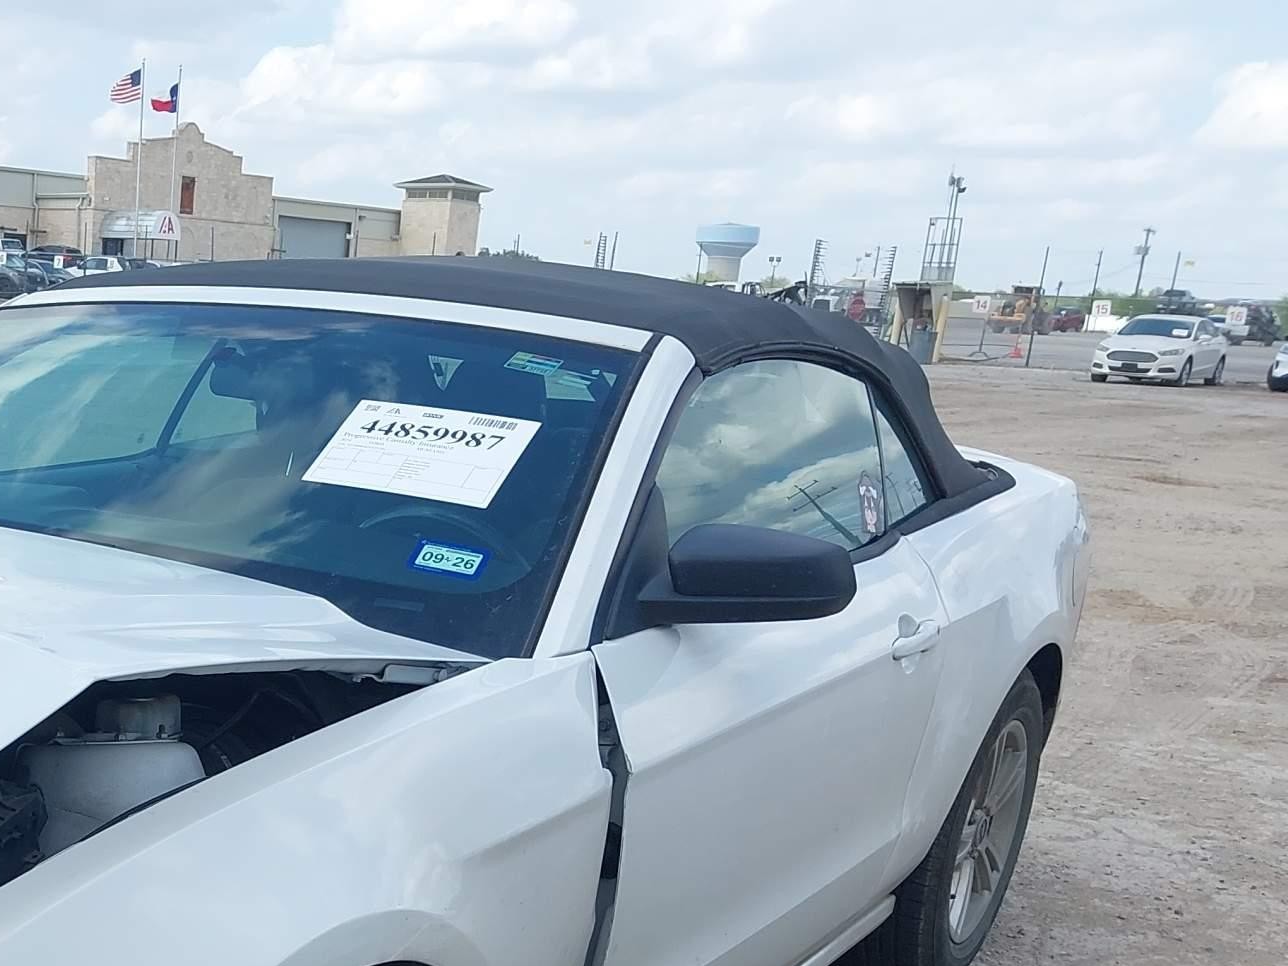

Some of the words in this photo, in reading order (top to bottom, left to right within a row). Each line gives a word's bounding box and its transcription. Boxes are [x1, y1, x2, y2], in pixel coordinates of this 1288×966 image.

[976, 300, 988, 310] 14
[1095, 304, 1109, 314] 15
[360, 419, 506, 451] 44859987
[421, 551, 445, 564] 09
[452, 557, 476, 570] 26
